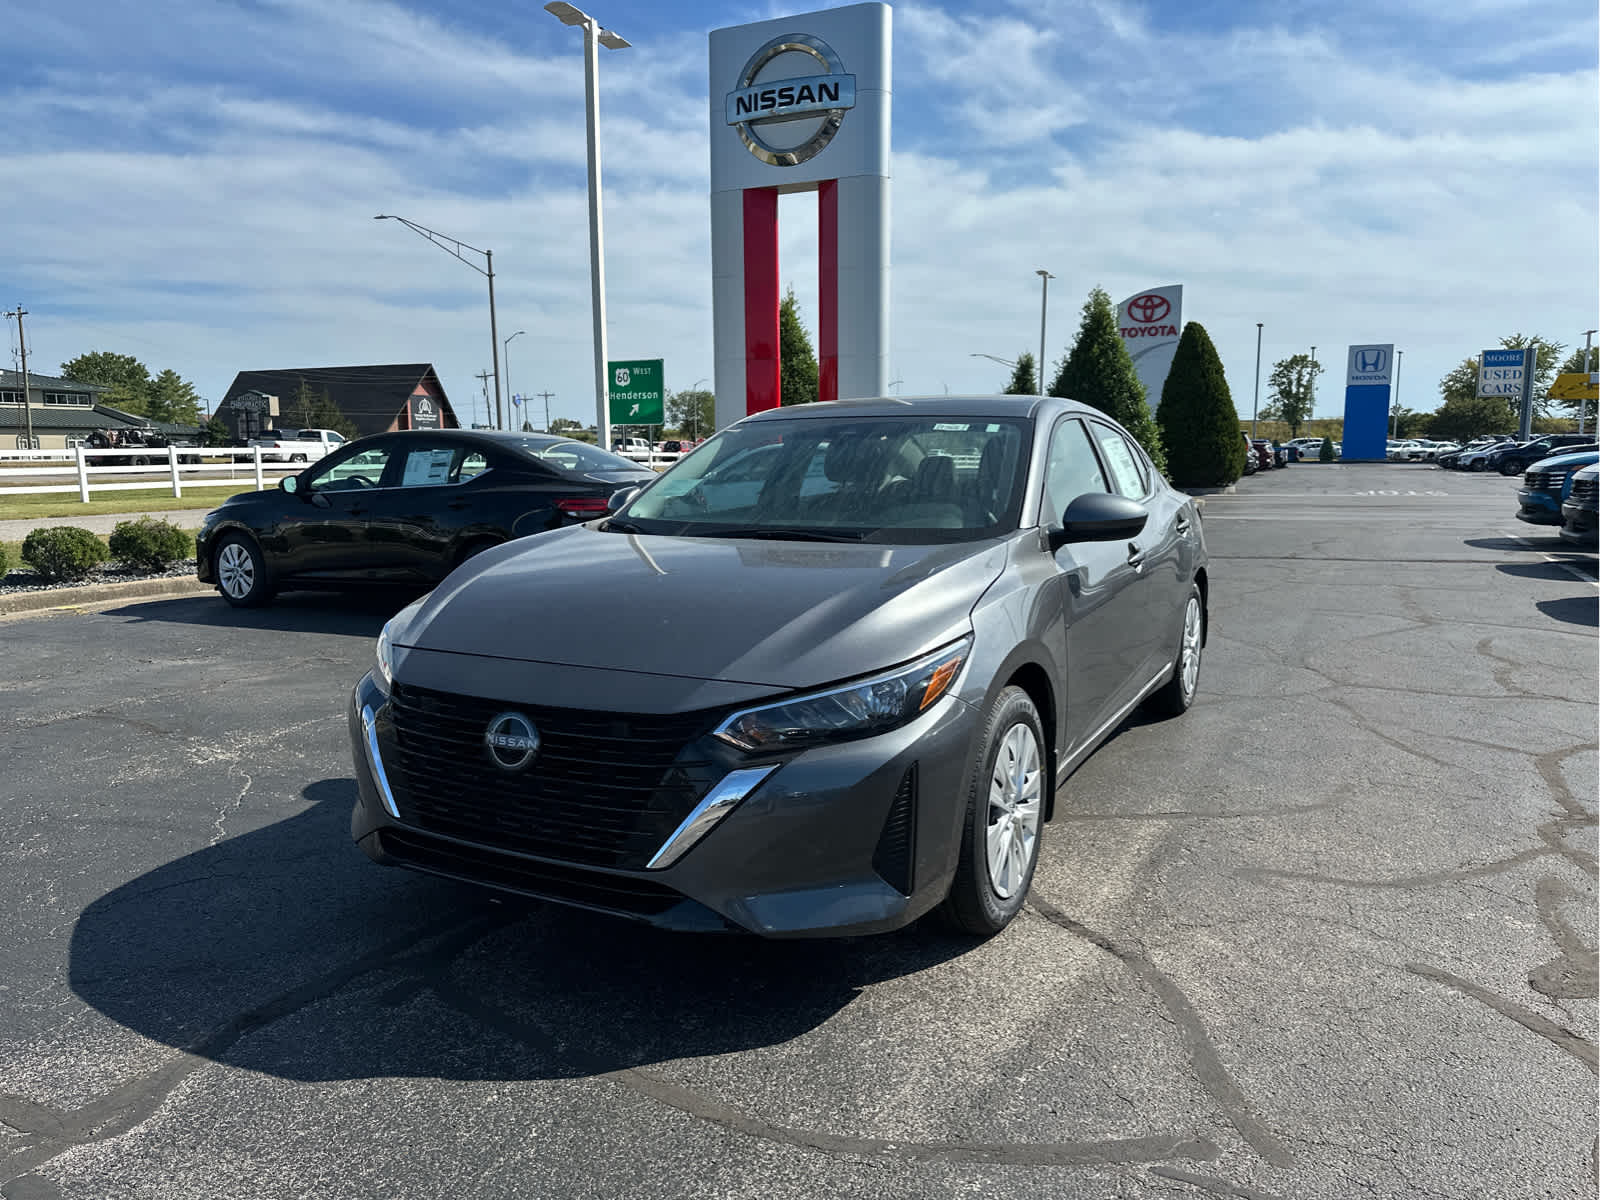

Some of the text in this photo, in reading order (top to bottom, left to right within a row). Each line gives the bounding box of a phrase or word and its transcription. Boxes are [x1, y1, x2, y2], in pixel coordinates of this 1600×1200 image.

[736, 82, 839, 115] NISSAN
[1120, 324, 1177, 338] TOYOTA
[617, 371, 629, 383] 60
[1483, 369, 1522, 380] USED
[1481, 383, 1521, 393] CARS
[609, 391, 658, 400] Henderson
[487, 733, 537, 749] NISSAN
